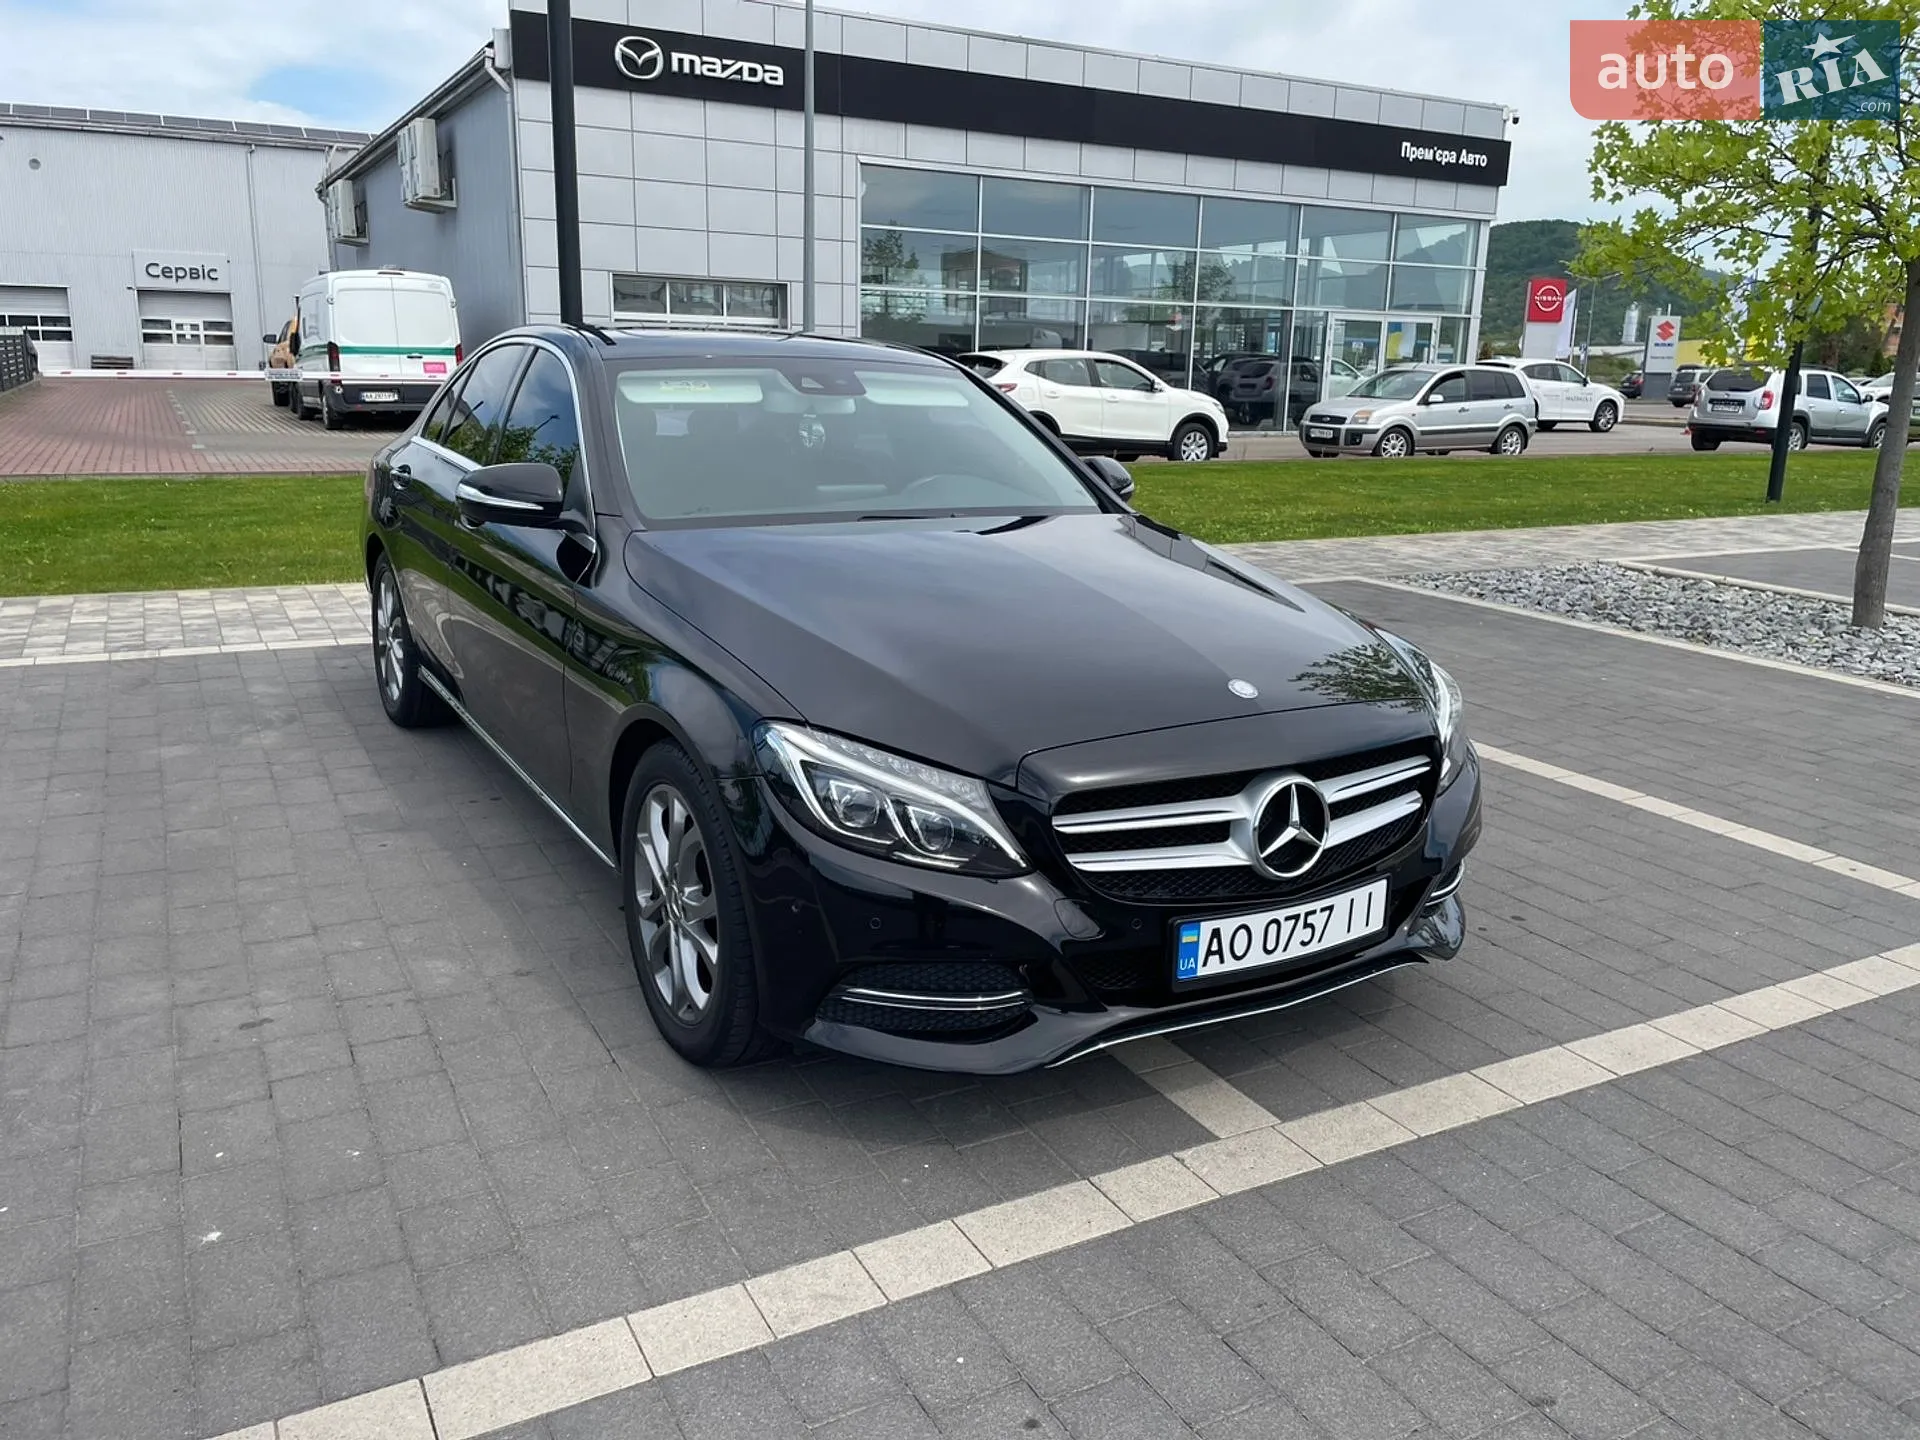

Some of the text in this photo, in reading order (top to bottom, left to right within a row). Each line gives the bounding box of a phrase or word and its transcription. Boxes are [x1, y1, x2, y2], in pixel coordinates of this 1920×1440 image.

[670, 51, 784, 87] mazda
[1458, 148, 1488, 167] Авто
[145, 262, 219, 283] Сервіс
[1201, 923, 1253, 968] AO
[1262, 904, 1335, 956] 0757
[1179, 956, 1196, 971] UA
